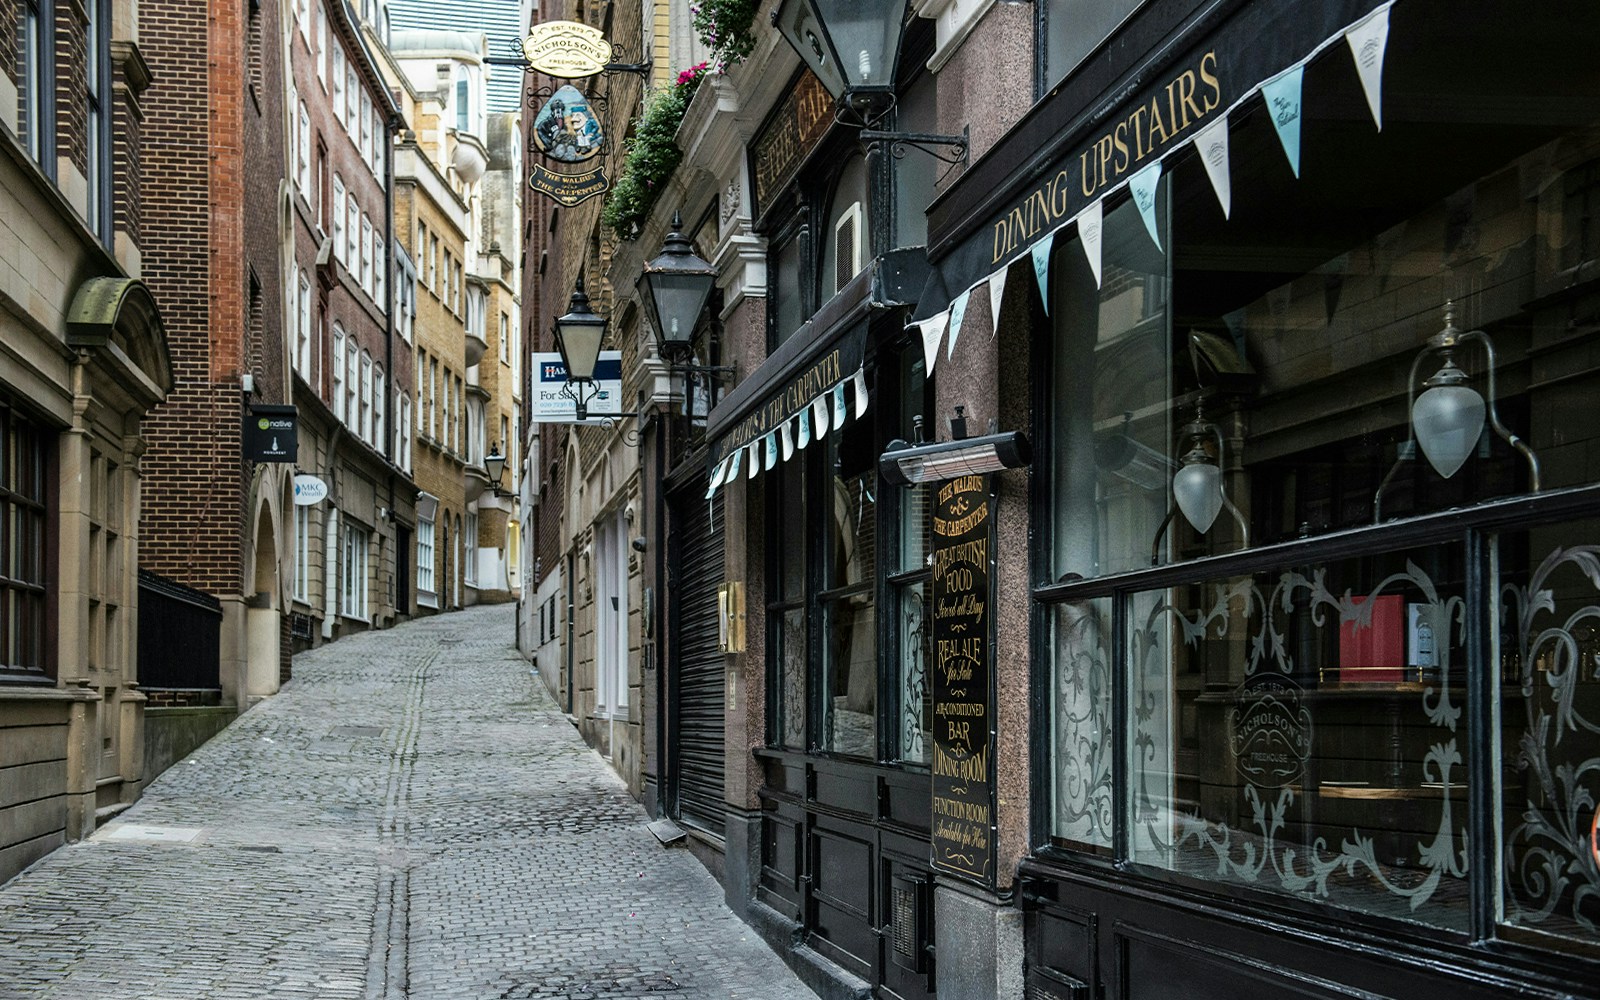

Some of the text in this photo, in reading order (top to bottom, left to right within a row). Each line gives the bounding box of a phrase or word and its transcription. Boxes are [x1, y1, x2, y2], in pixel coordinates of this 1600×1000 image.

[534, 40, 602, 59] NICHOLSON'S
[991, 49, 1221, 265] DINING UPSTAIRS
[537, 180, 605, 196] THE CARPENTER
[543, 172, 596, 184] THE WALRUS
[540, 391, 556, 400] For
[769, 393, 785, 428] THE
[786, 349, 841, 414] CARPENTER
[270, 420, 292, 428] native
[302, 483, 322, 491] MKC
[939, 475, 983, 506] THE WALRUS
[934, 501, 988, 537] THE CARPENTER
[953, 496, 969, 516] &
[934, 537, 987, 581] GREAT BRITISH
[946, 568, 973, 593] FOOD
[966, 593, 985, 624] Day
[938, 638, 981, 675] REAL ALE
[936, 703, 984, 718] AIR-CONDITIONED
[948, 721, 972, 751] BAR
[1237, 713, 1302, 747] NICHOLSON'S
[934, 739, 987, 786] DINING ROOM
[1250, 752, 1288, 763] FREEHOUSE
[934, 796, 987, 824] FUNCTION ROOM
[935, 819, 961, 842] Available
